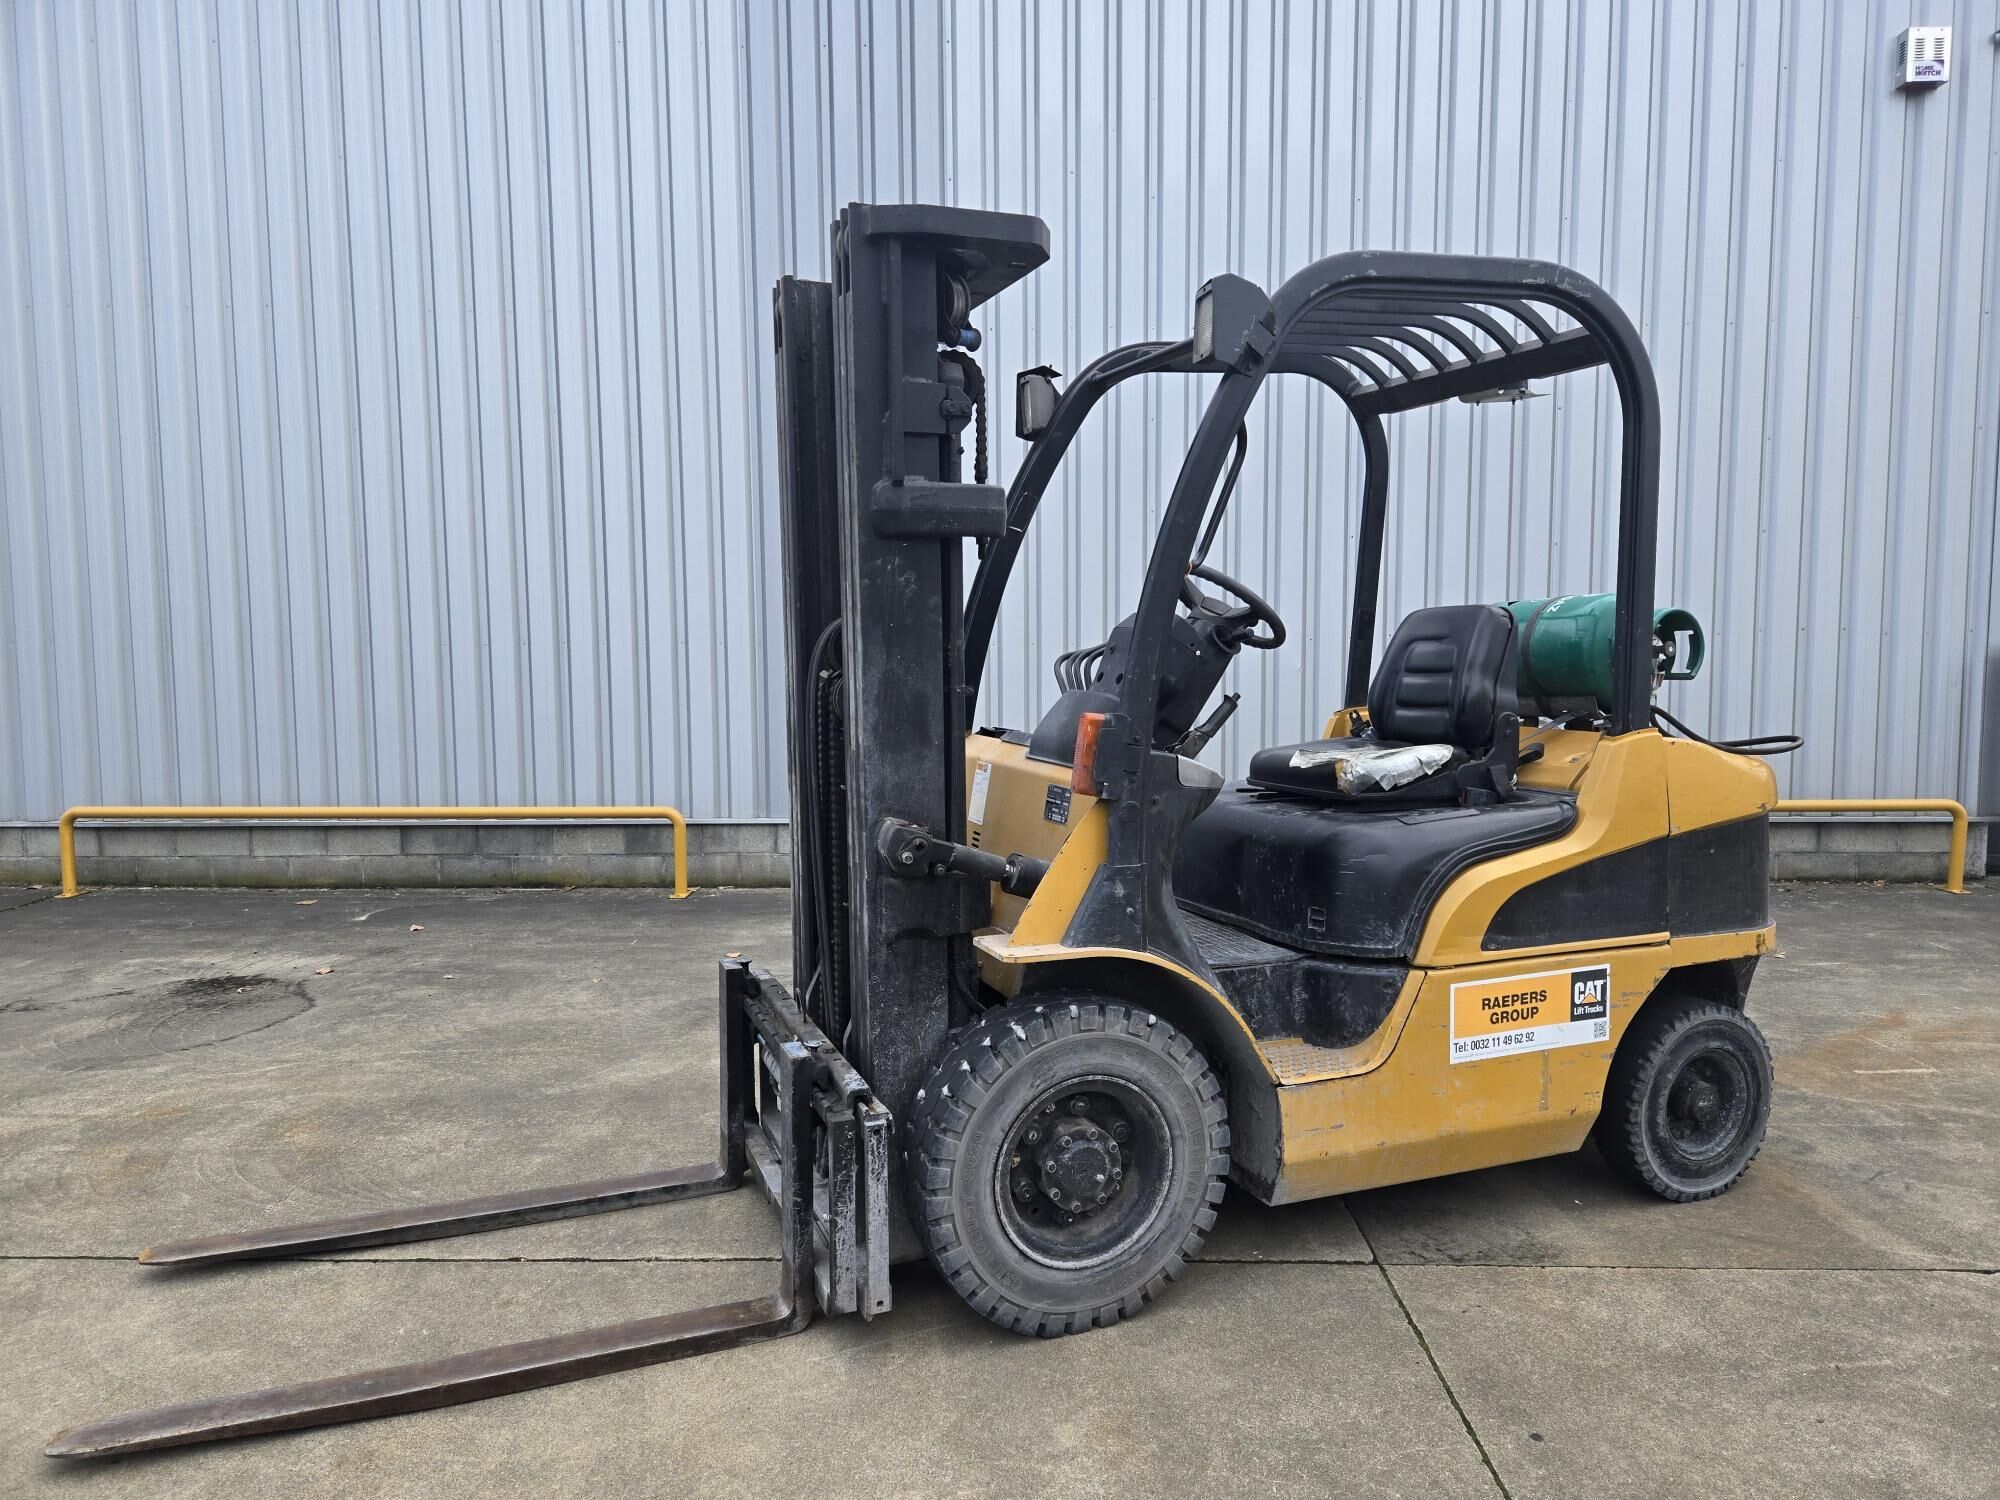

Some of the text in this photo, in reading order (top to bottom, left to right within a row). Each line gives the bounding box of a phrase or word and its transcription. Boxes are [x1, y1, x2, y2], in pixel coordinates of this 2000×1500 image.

[1481, 990, 1548, 1011] RAEPERS
[1574, 979, 1604, 1004] CAT
[1490, 1006, 1539, 1025] GROUP
[1573, 1004, 1604, 1016] Lift Trucks
[1453, 1040, 1469, 1054] Tel:
[1470, 1038, 1490, 1051] 0032
[1492, 1036, 1500, 1047] 11
[1503, 1035, 1512, 1046] 49
[1514, 1033, 1524, 1044] 62
[1525, 1031, 1535, 1042] 92
[961, 1194, 995, 1266] ROBUST
